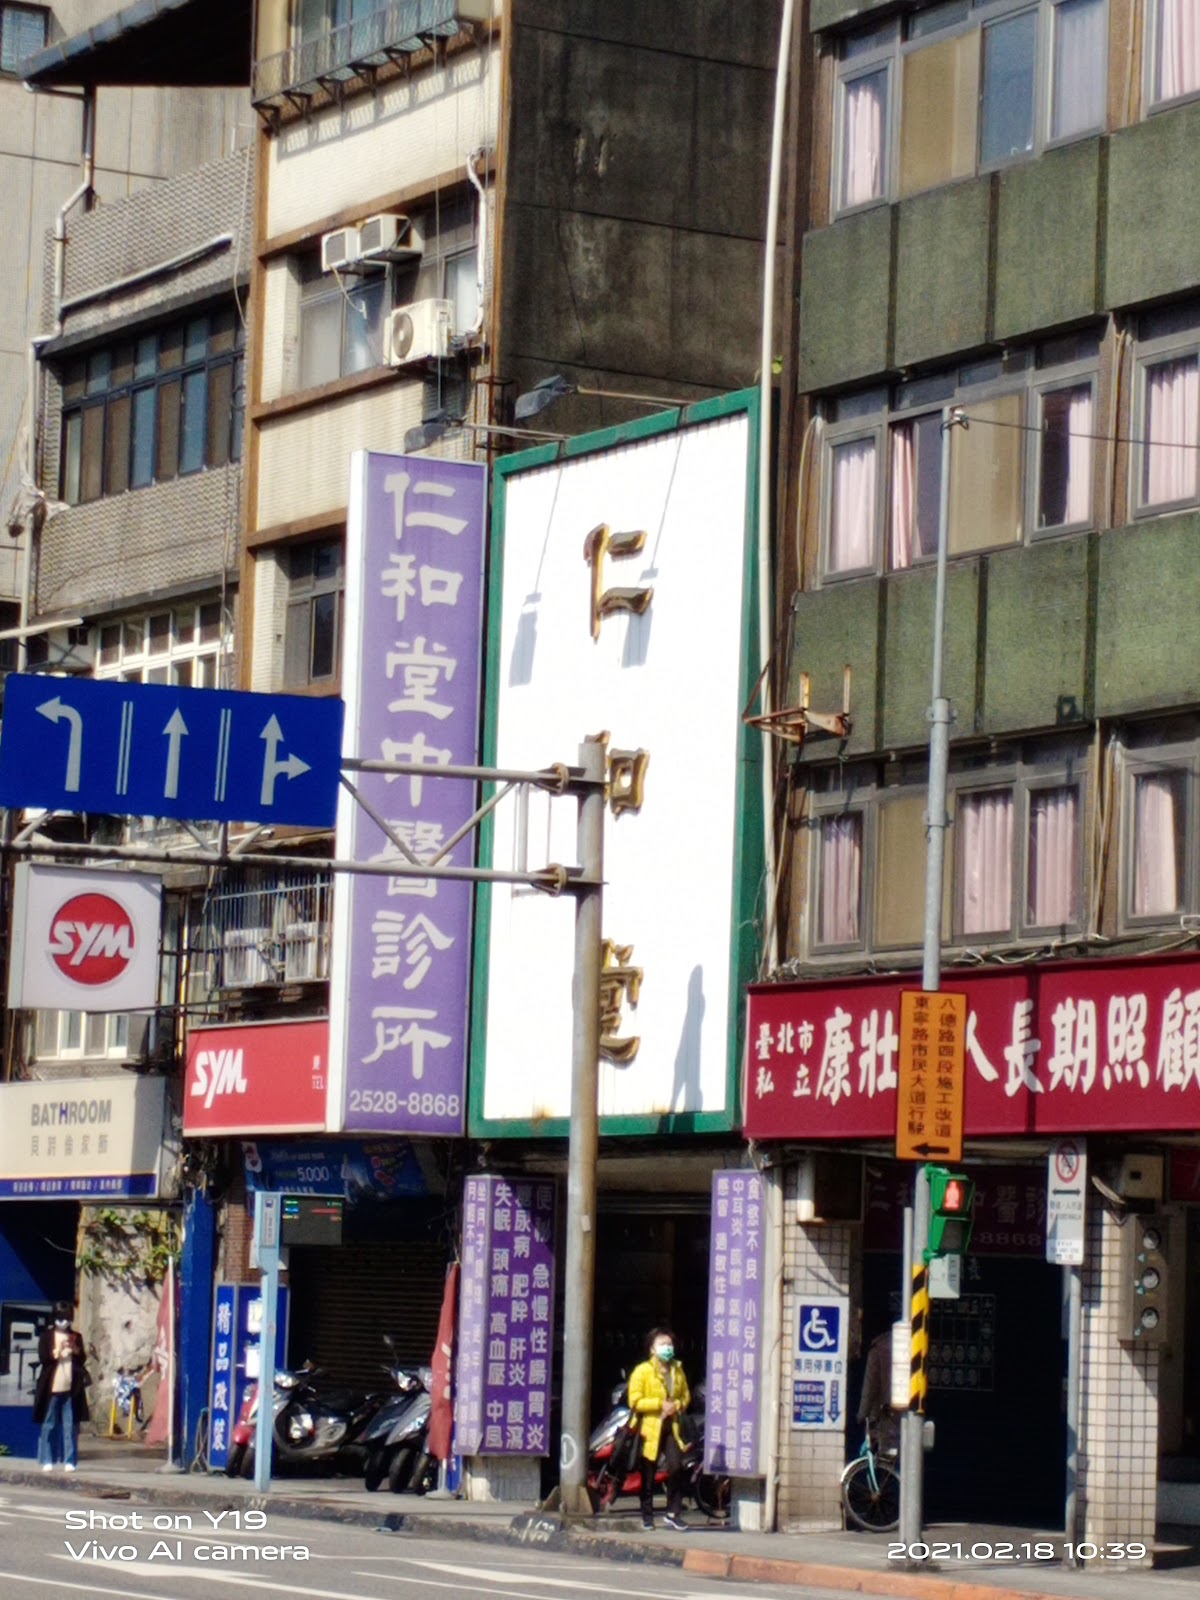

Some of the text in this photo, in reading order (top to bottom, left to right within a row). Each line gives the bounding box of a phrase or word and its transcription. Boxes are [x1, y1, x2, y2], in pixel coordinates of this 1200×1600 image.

[361, 471, 469, 1080] 仁和堂中醫診所
[47, 921, 135, 966] SYM
[755, 1020, 815, 1060] 臺北市
[908, 996, 929, 1136] 東寧路市民大道行駛
[190, 1048, 247, 1109] SYM
[935, 998, 957, 1138] 八德路四段施工改道
[31, 1099, 112, 1127] BATHROOM
[349, 1090, 460, 1118] 2528-8868
[494, 1183, 512, 1231] 失眠
[731, 1179, 744, 1236] 中耳炎
[491, 1248, 509, 1297] 頭痛
[511, 1274, 529, 1322] 肥胖
[488, 1312, 507, 1385] 高血壓
[508, 1338, 526, 1386] 肝炎
[526, 1263, 549, 1450] 急慢性腸胃炎
[212, 1303, 231, 1450] 精品改裝
